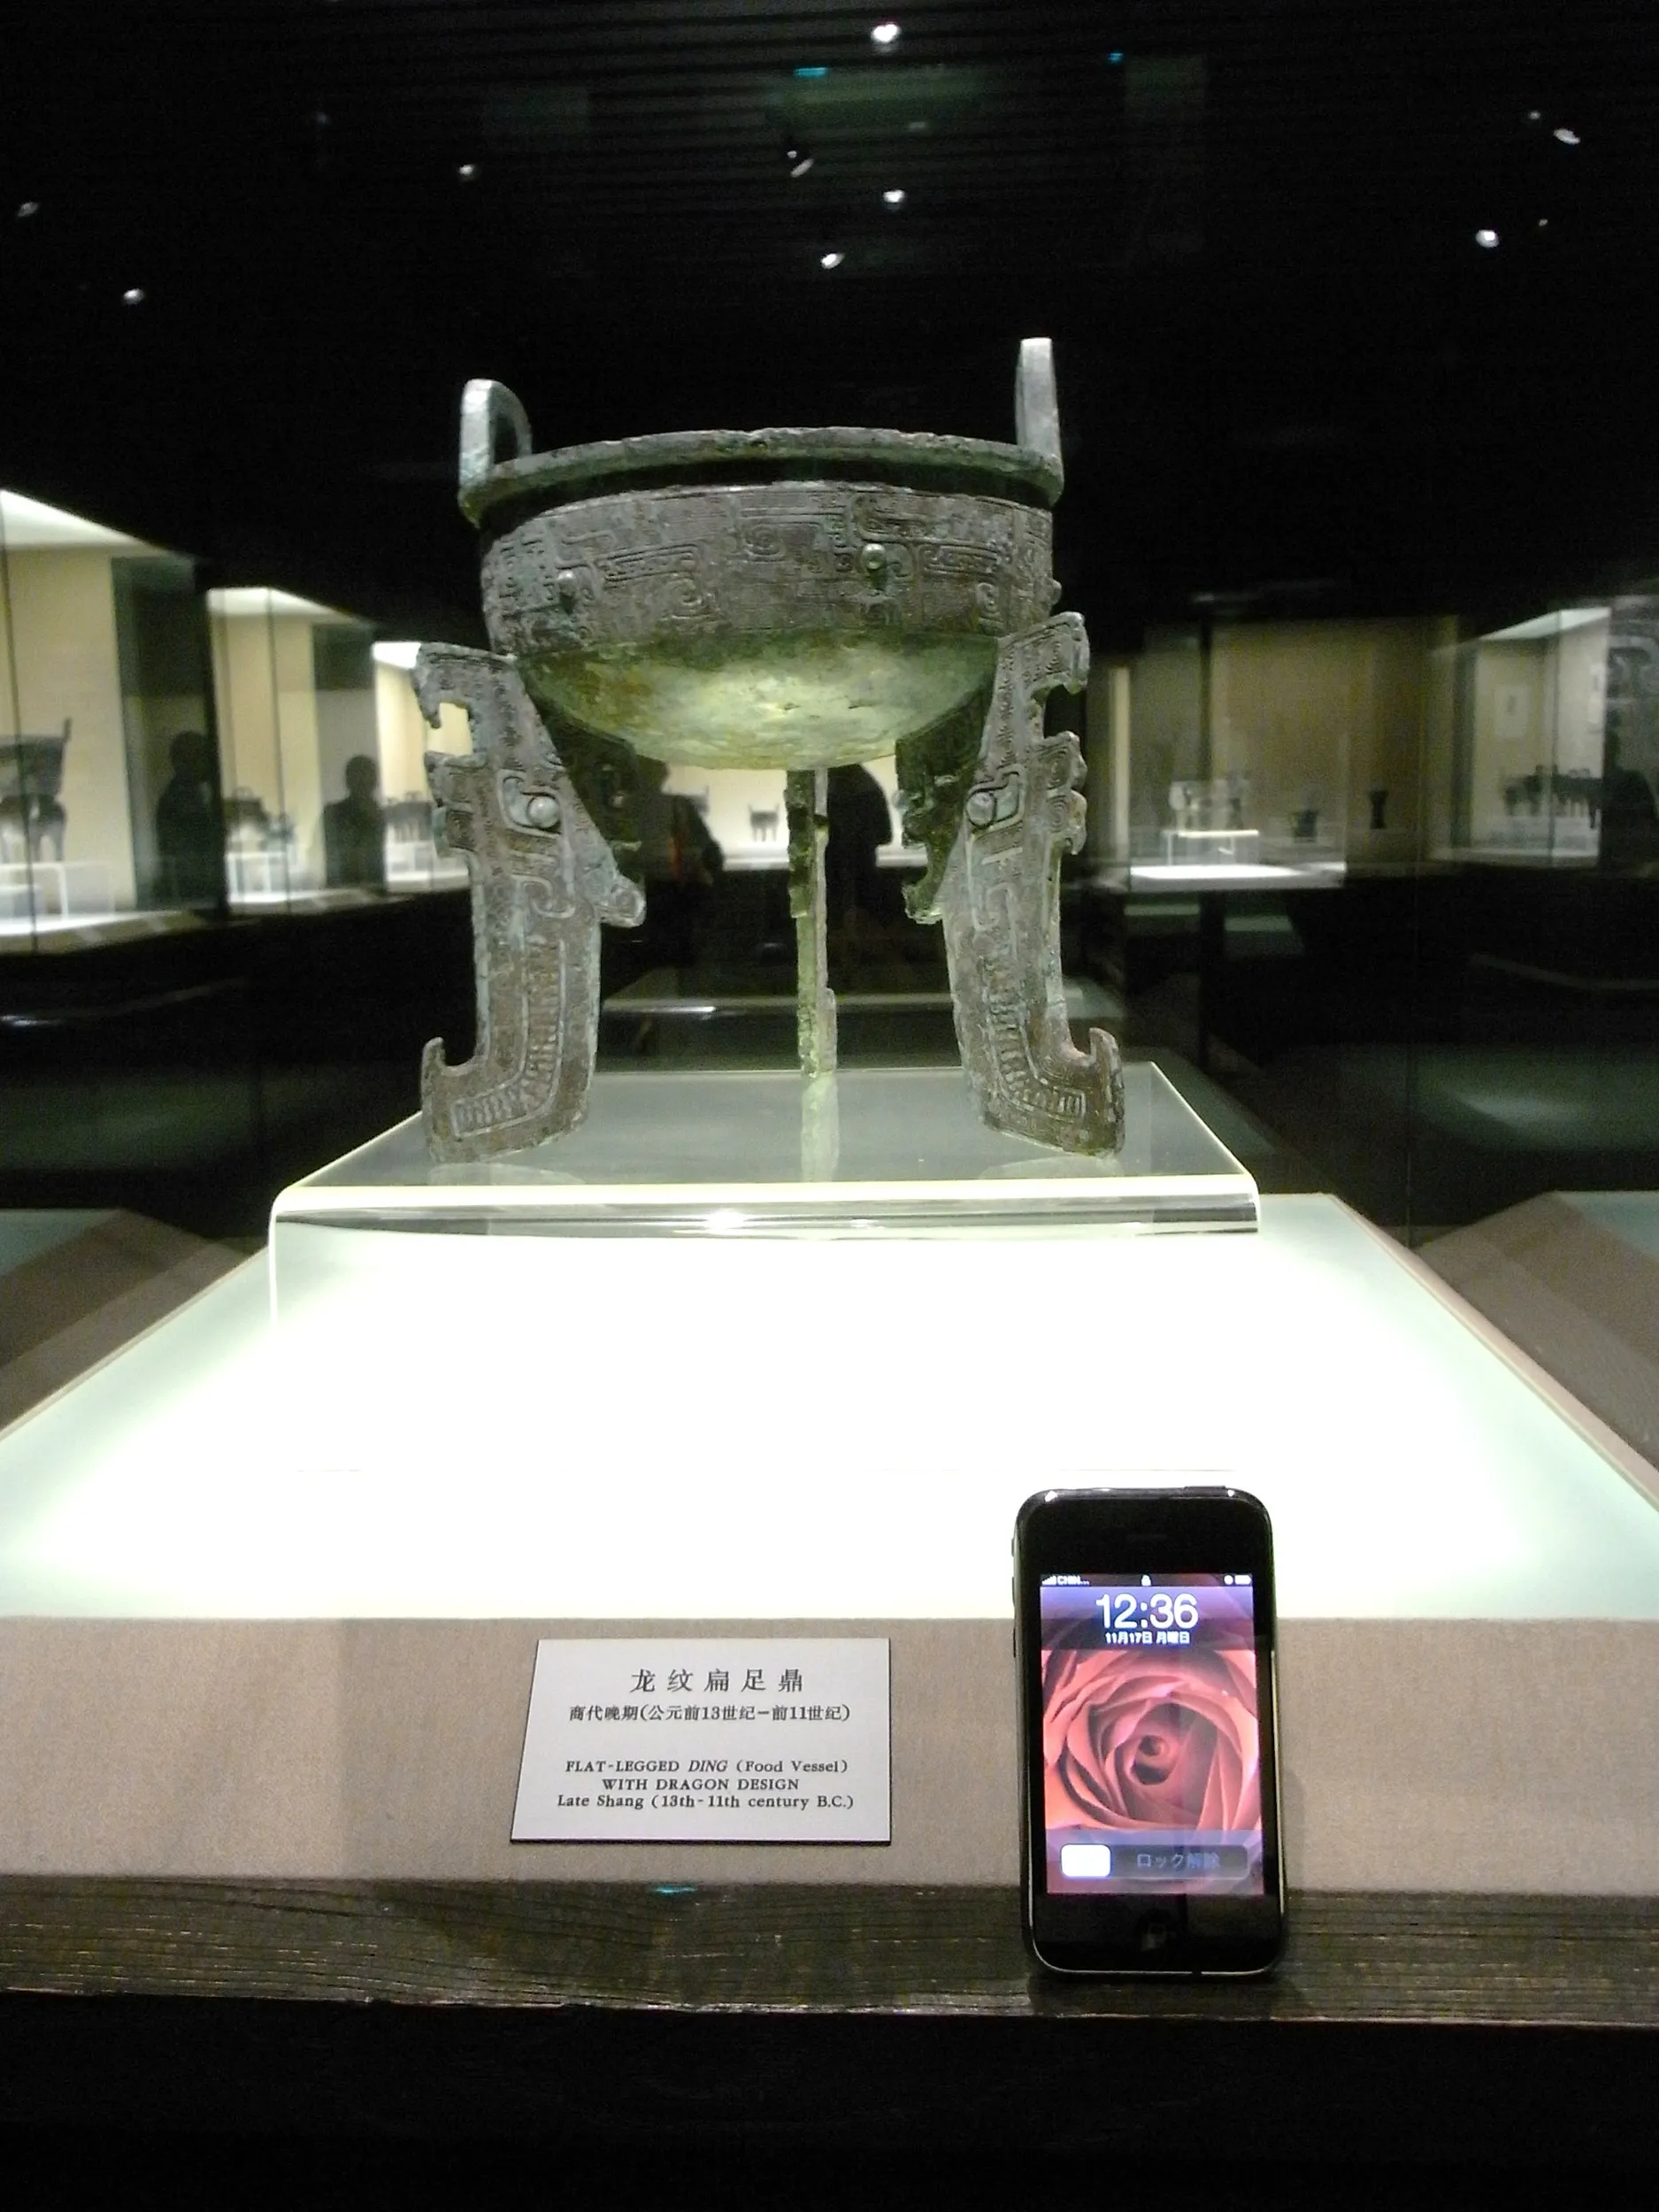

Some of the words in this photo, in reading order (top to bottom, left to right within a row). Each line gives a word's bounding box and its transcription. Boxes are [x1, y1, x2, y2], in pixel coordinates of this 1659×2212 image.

[1095, 1594, 1199, 1630] 12:36
[629, 1668, 803, 1694] 龙纹扁足鼎
[565, 1760, 680, 1773] FLAT-LEGGED
[687, 1759, 728, 1773] DING
[736, 1760, 783, 1773] (Food
[790, 1759, 849, 1774] Vessel)
[602, 1778, 649, 1791] WITH
[656, 1778, 730, 1791] DRAGON
[737, 1778, 800, 1791] DESIGN
[557, 1794, 590, 1807] Late
[596, 1794, 645, 1810] Shang
[748, 1796, 810, 1811] century
[817, 1794, 855, 1810] B.C.)
